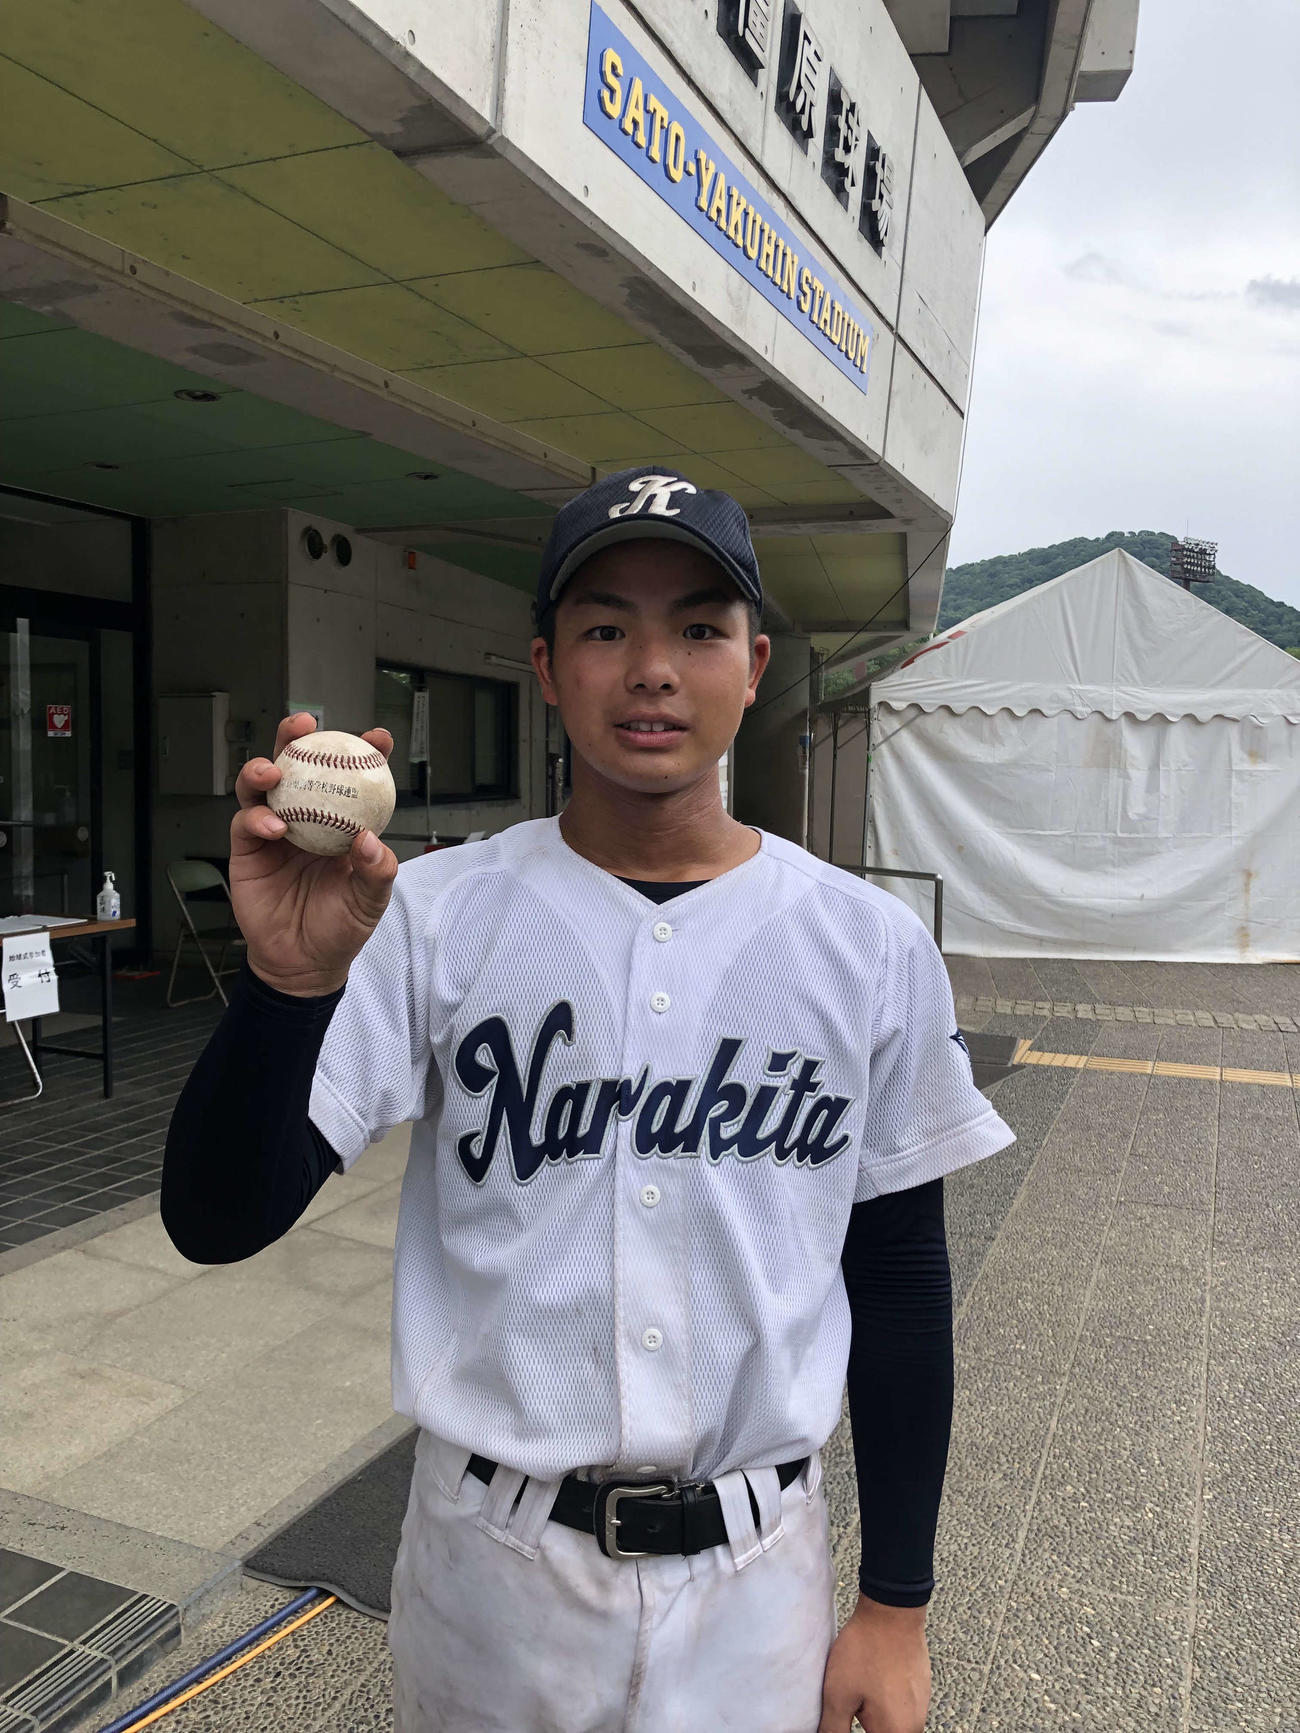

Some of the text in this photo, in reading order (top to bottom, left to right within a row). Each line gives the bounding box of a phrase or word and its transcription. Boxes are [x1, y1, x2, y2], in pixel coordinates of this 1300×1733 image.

[798, 266, 870, 374] STADIUM
[608, 474, 697, 519] K
[49, 705, 69, 714] AED
[455, 999, 852, 1186] Narakita
